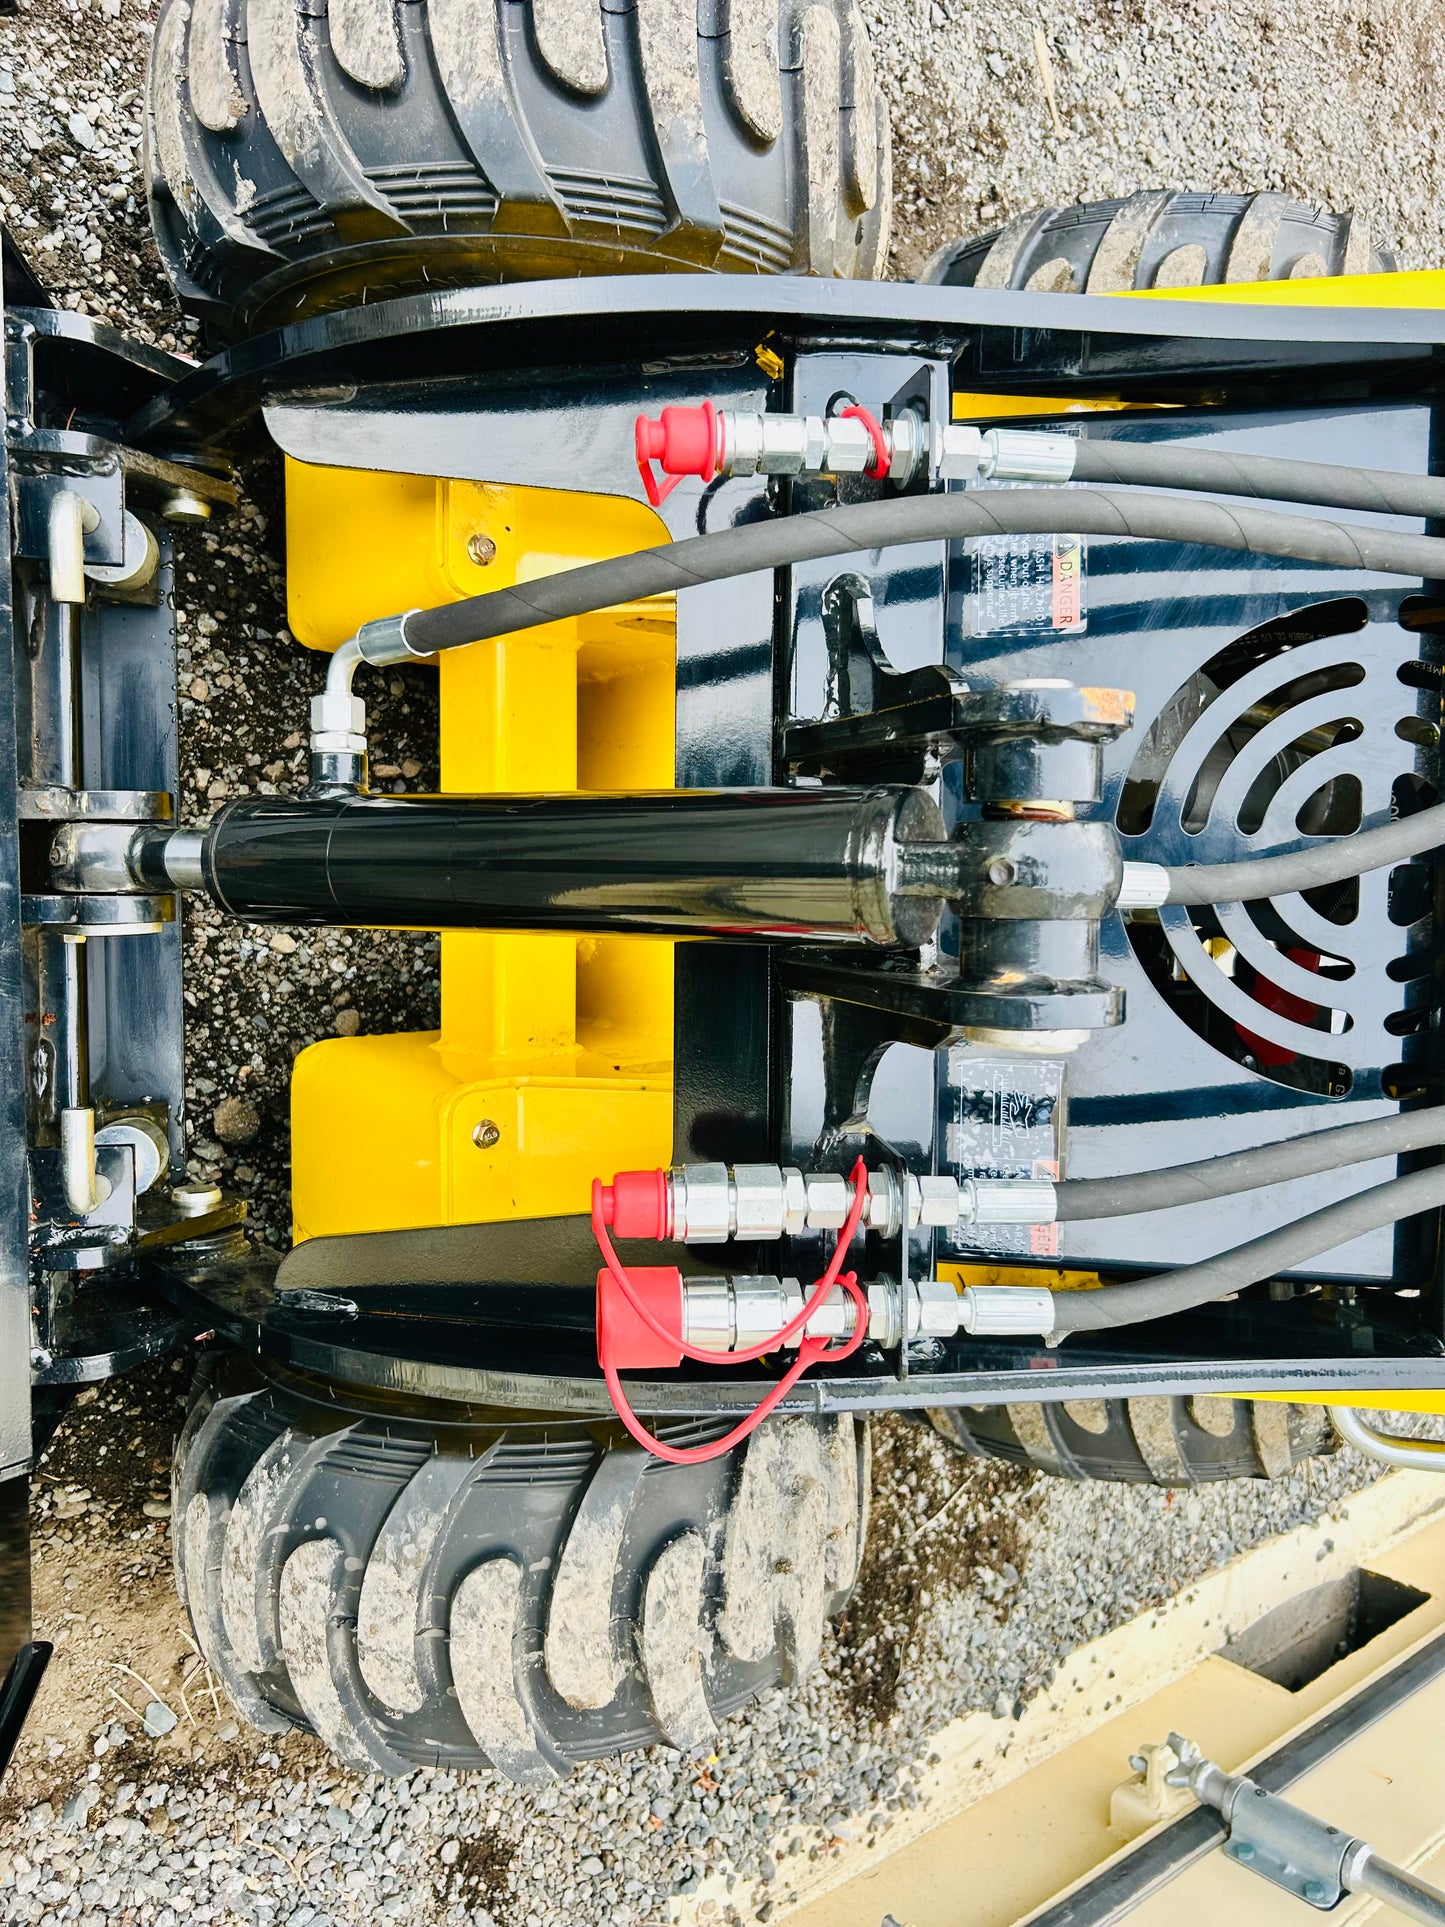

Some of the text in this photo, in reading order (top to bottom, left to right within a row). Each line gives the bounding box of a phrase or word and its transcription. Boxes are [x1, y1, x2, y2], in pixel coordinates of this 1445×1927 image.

[1021, 535, 1031, 560] Keep
[986, 559, 995, 567] is
[1010, 558, 1020, 585] when
[1022, 563, 1031, 579] out
[983, 569, 995, 617] supported
[1035, 535, 1045, 626] CRUSH HAZARD!
[1059, 561, 1073, 625] DANGER
